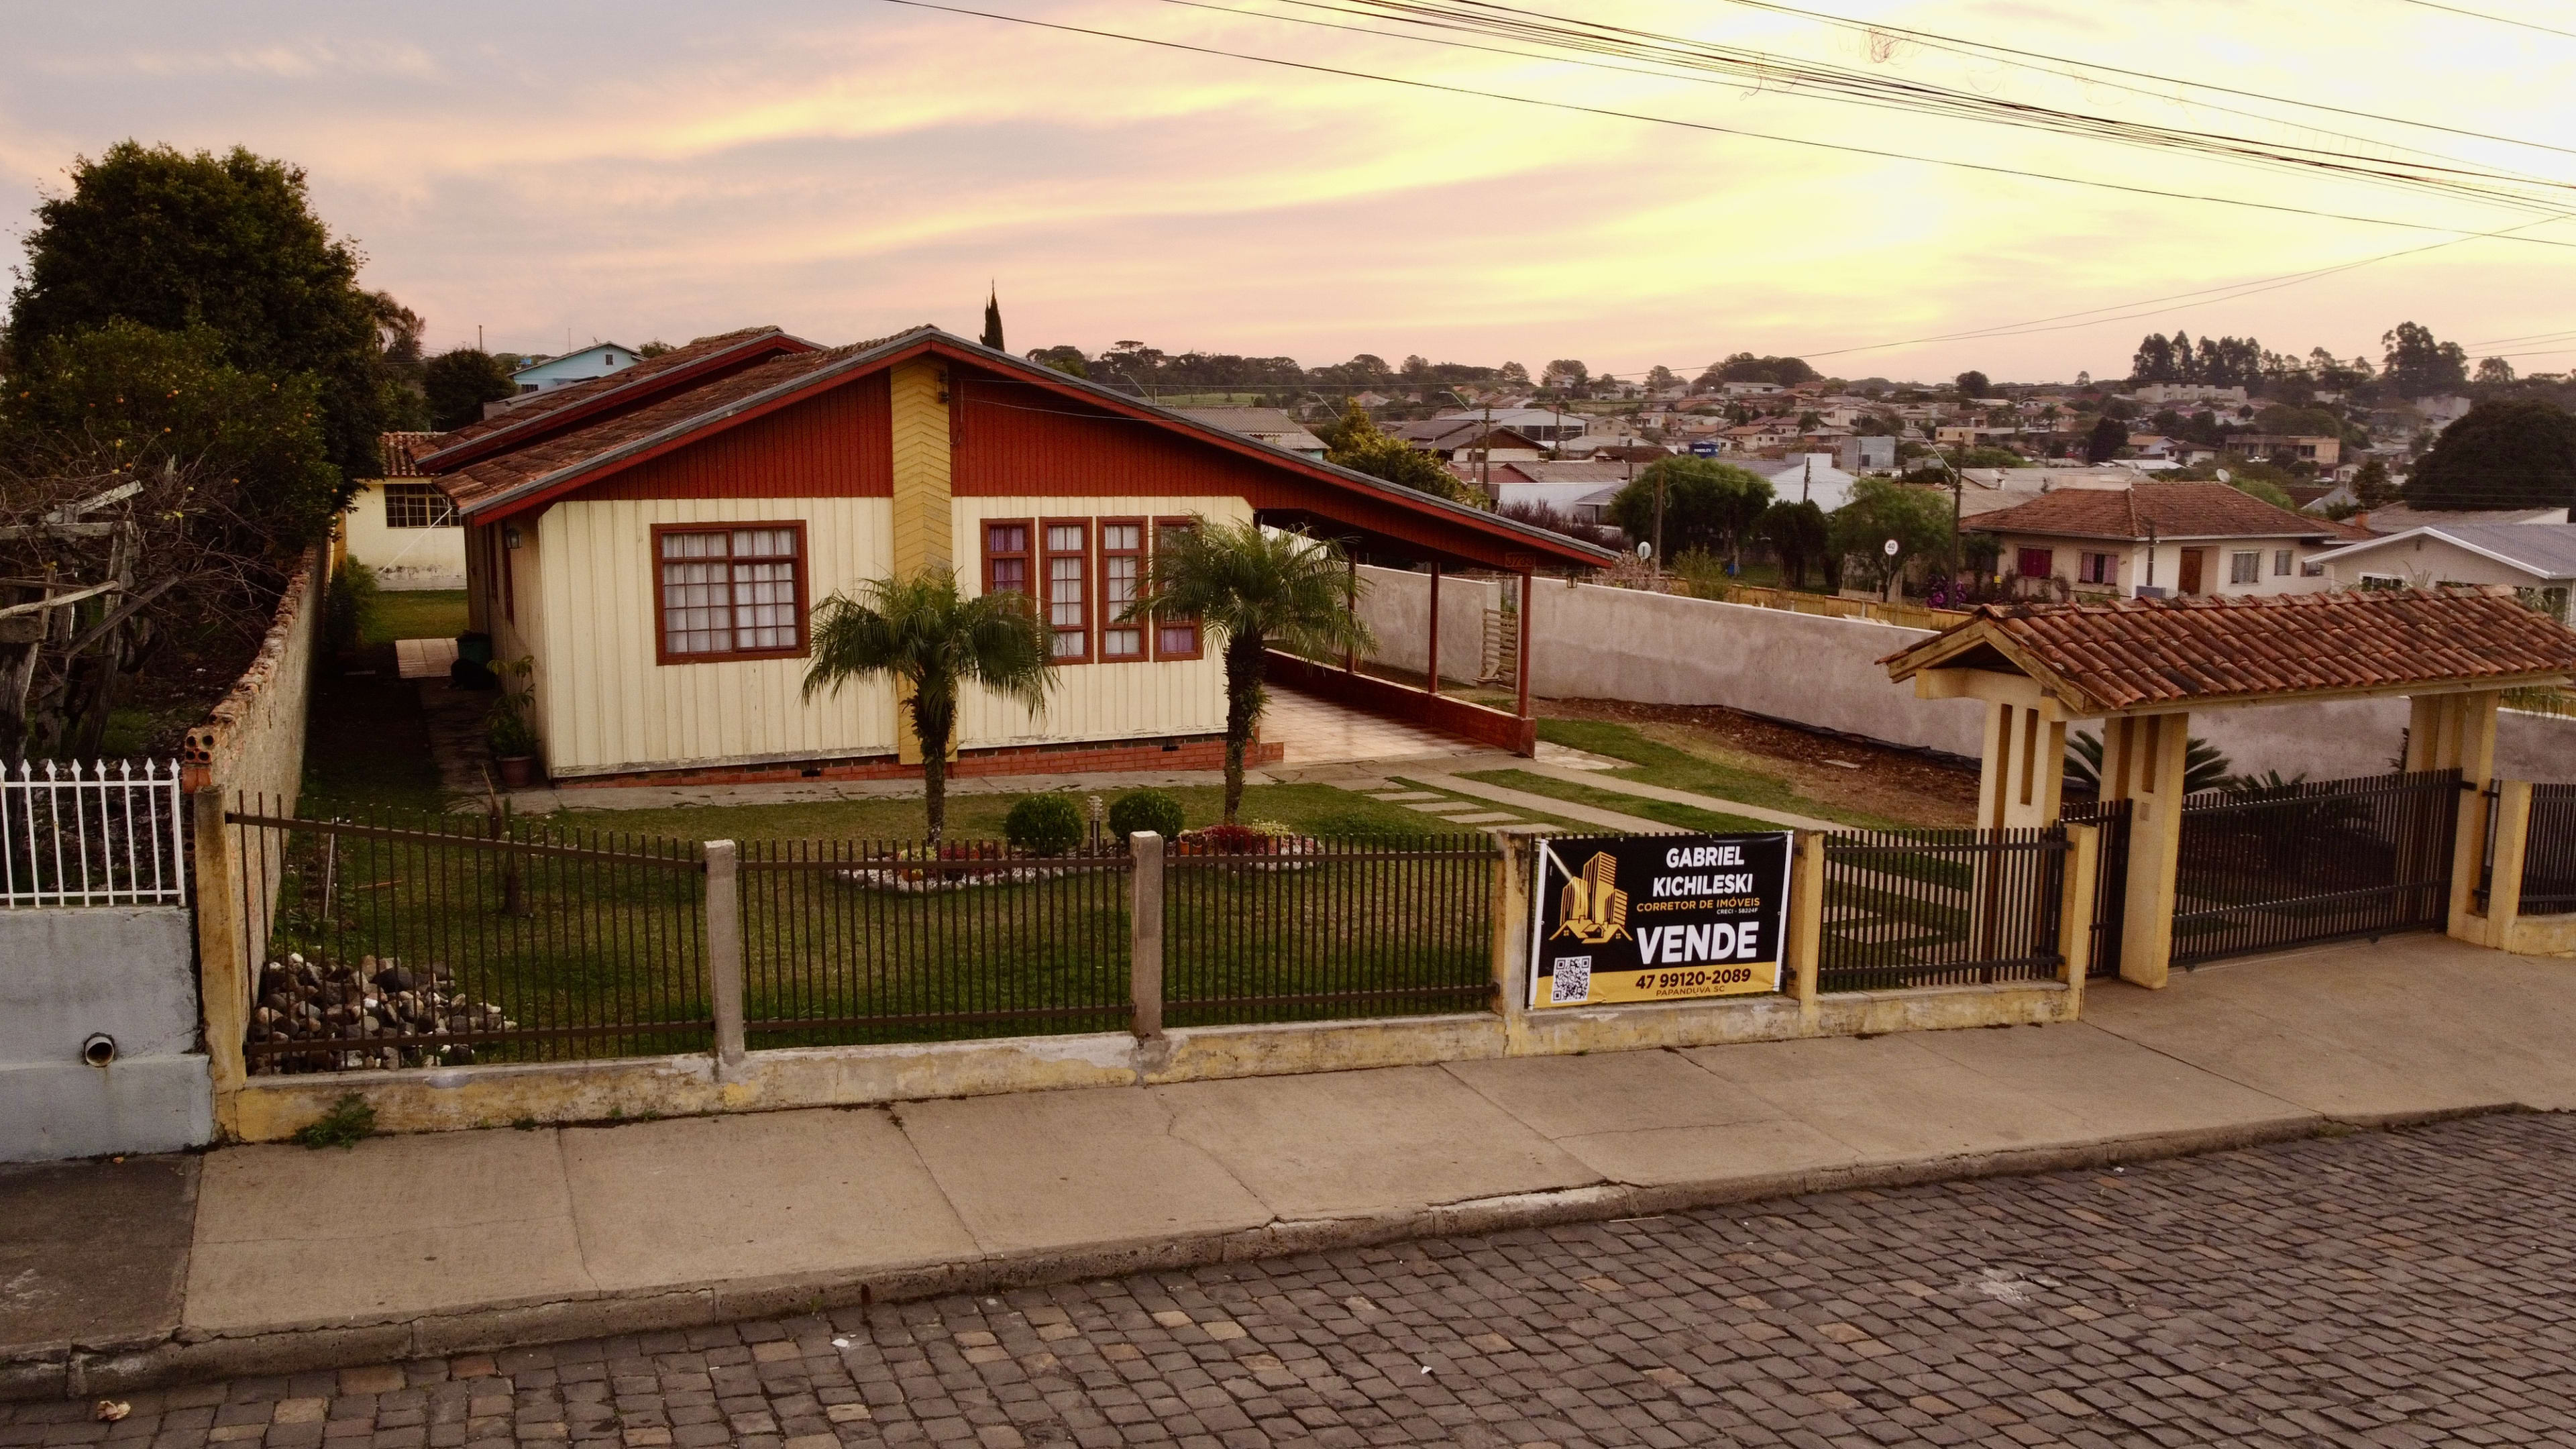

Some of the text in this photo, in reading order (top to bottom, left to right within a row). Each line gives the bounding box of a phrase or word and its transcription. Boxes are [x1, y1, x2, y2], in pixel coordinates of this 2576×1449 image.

[1666, 846, 1745, 868] GABRIEL
[1652, 873, 1753, 897] KICHILESKI
[1636, 896, 1760, 912] CORRETOR DE IMÓVEIS
[1636, 921, 1760, 965] VENDE
[1635, 968, 1752, 989] 47 99120-2089
[1656, 986, 1711, 996] PAPANDUVA
